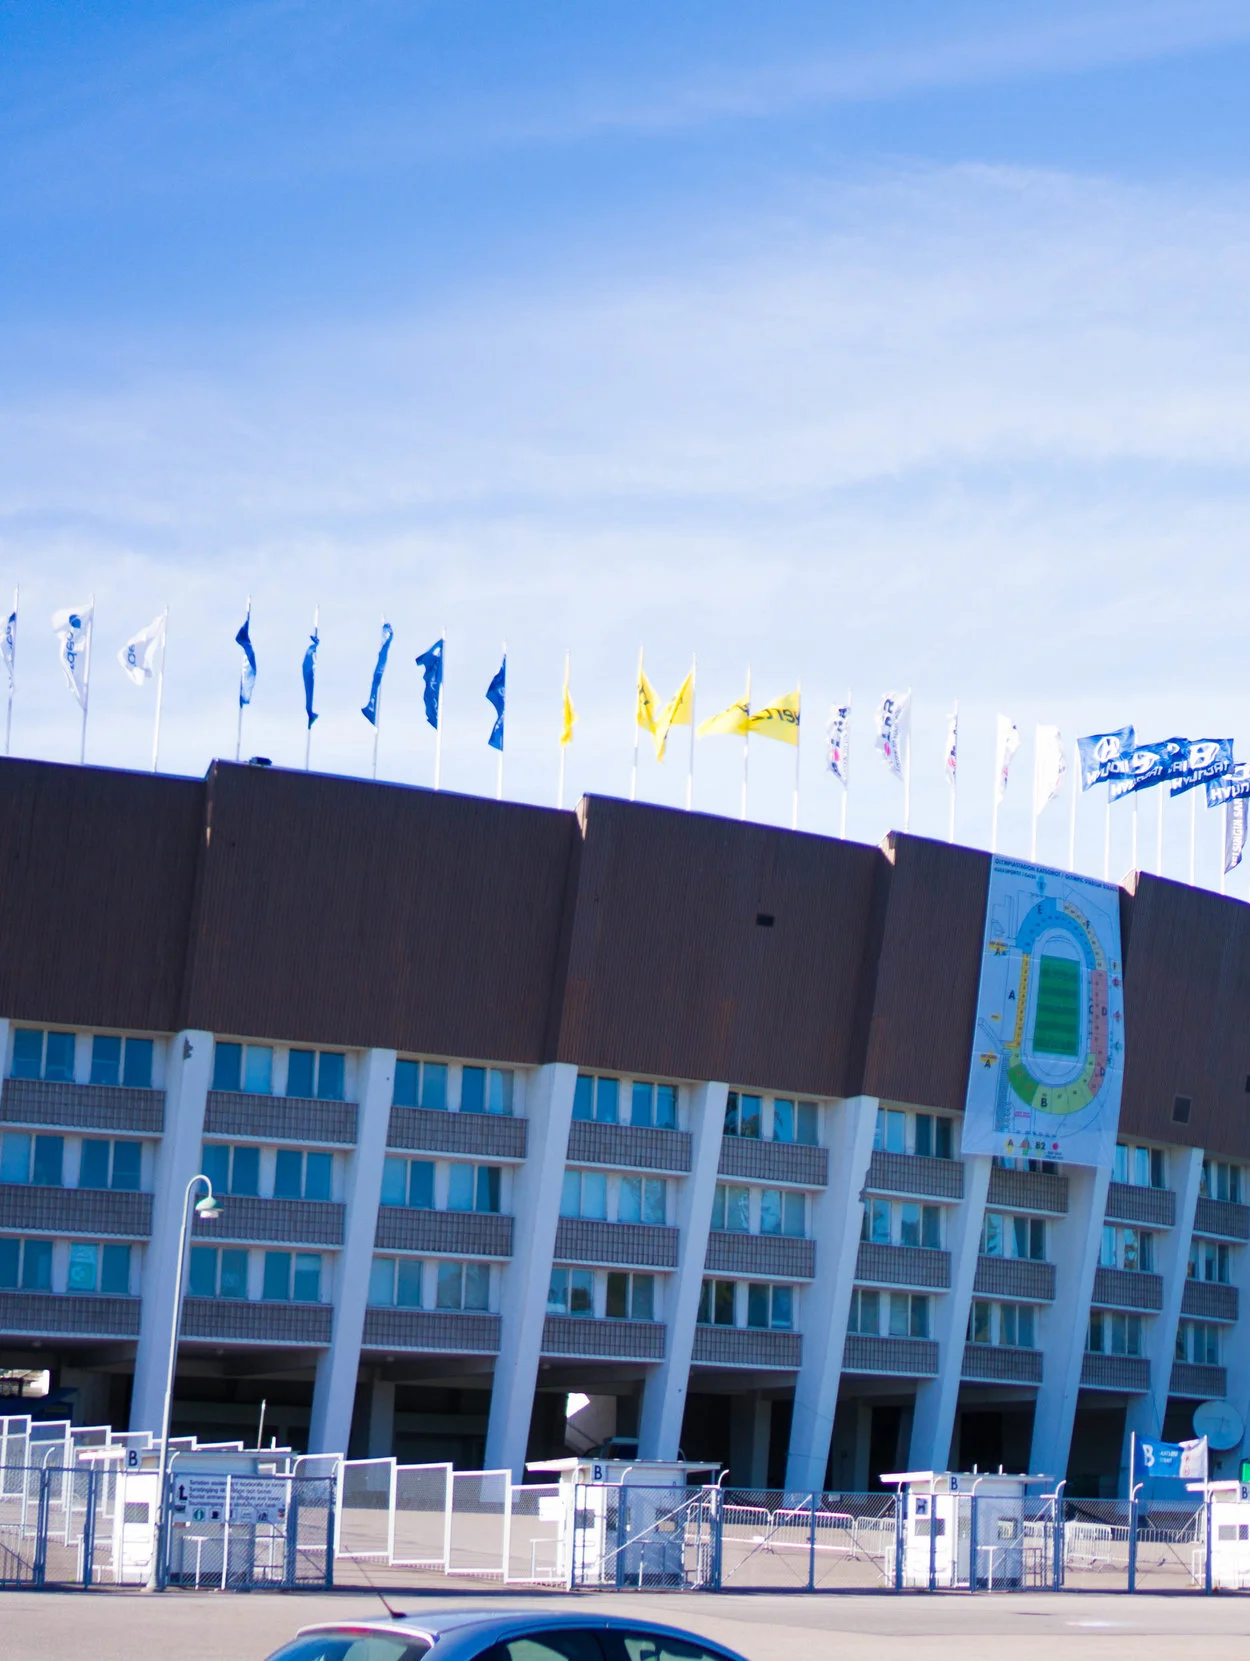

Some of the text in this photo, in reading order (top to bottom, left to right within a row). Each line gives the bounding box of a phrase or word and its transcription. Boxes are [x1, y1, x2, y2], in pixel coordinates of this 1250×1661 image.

[1170, 760, 1230, 790] HYUNDAI
[1008, 989, 1016, 1001] A
[1041, 1098, 1047, 1108] B
[129, 1450, 138, 1466] B
[1143, 1444, 1155, 1468] B
[594, 1465, 602, 1480] B
[951, 1476, 958, 1490] B
[1241, 1486, 1248, 1499] B
